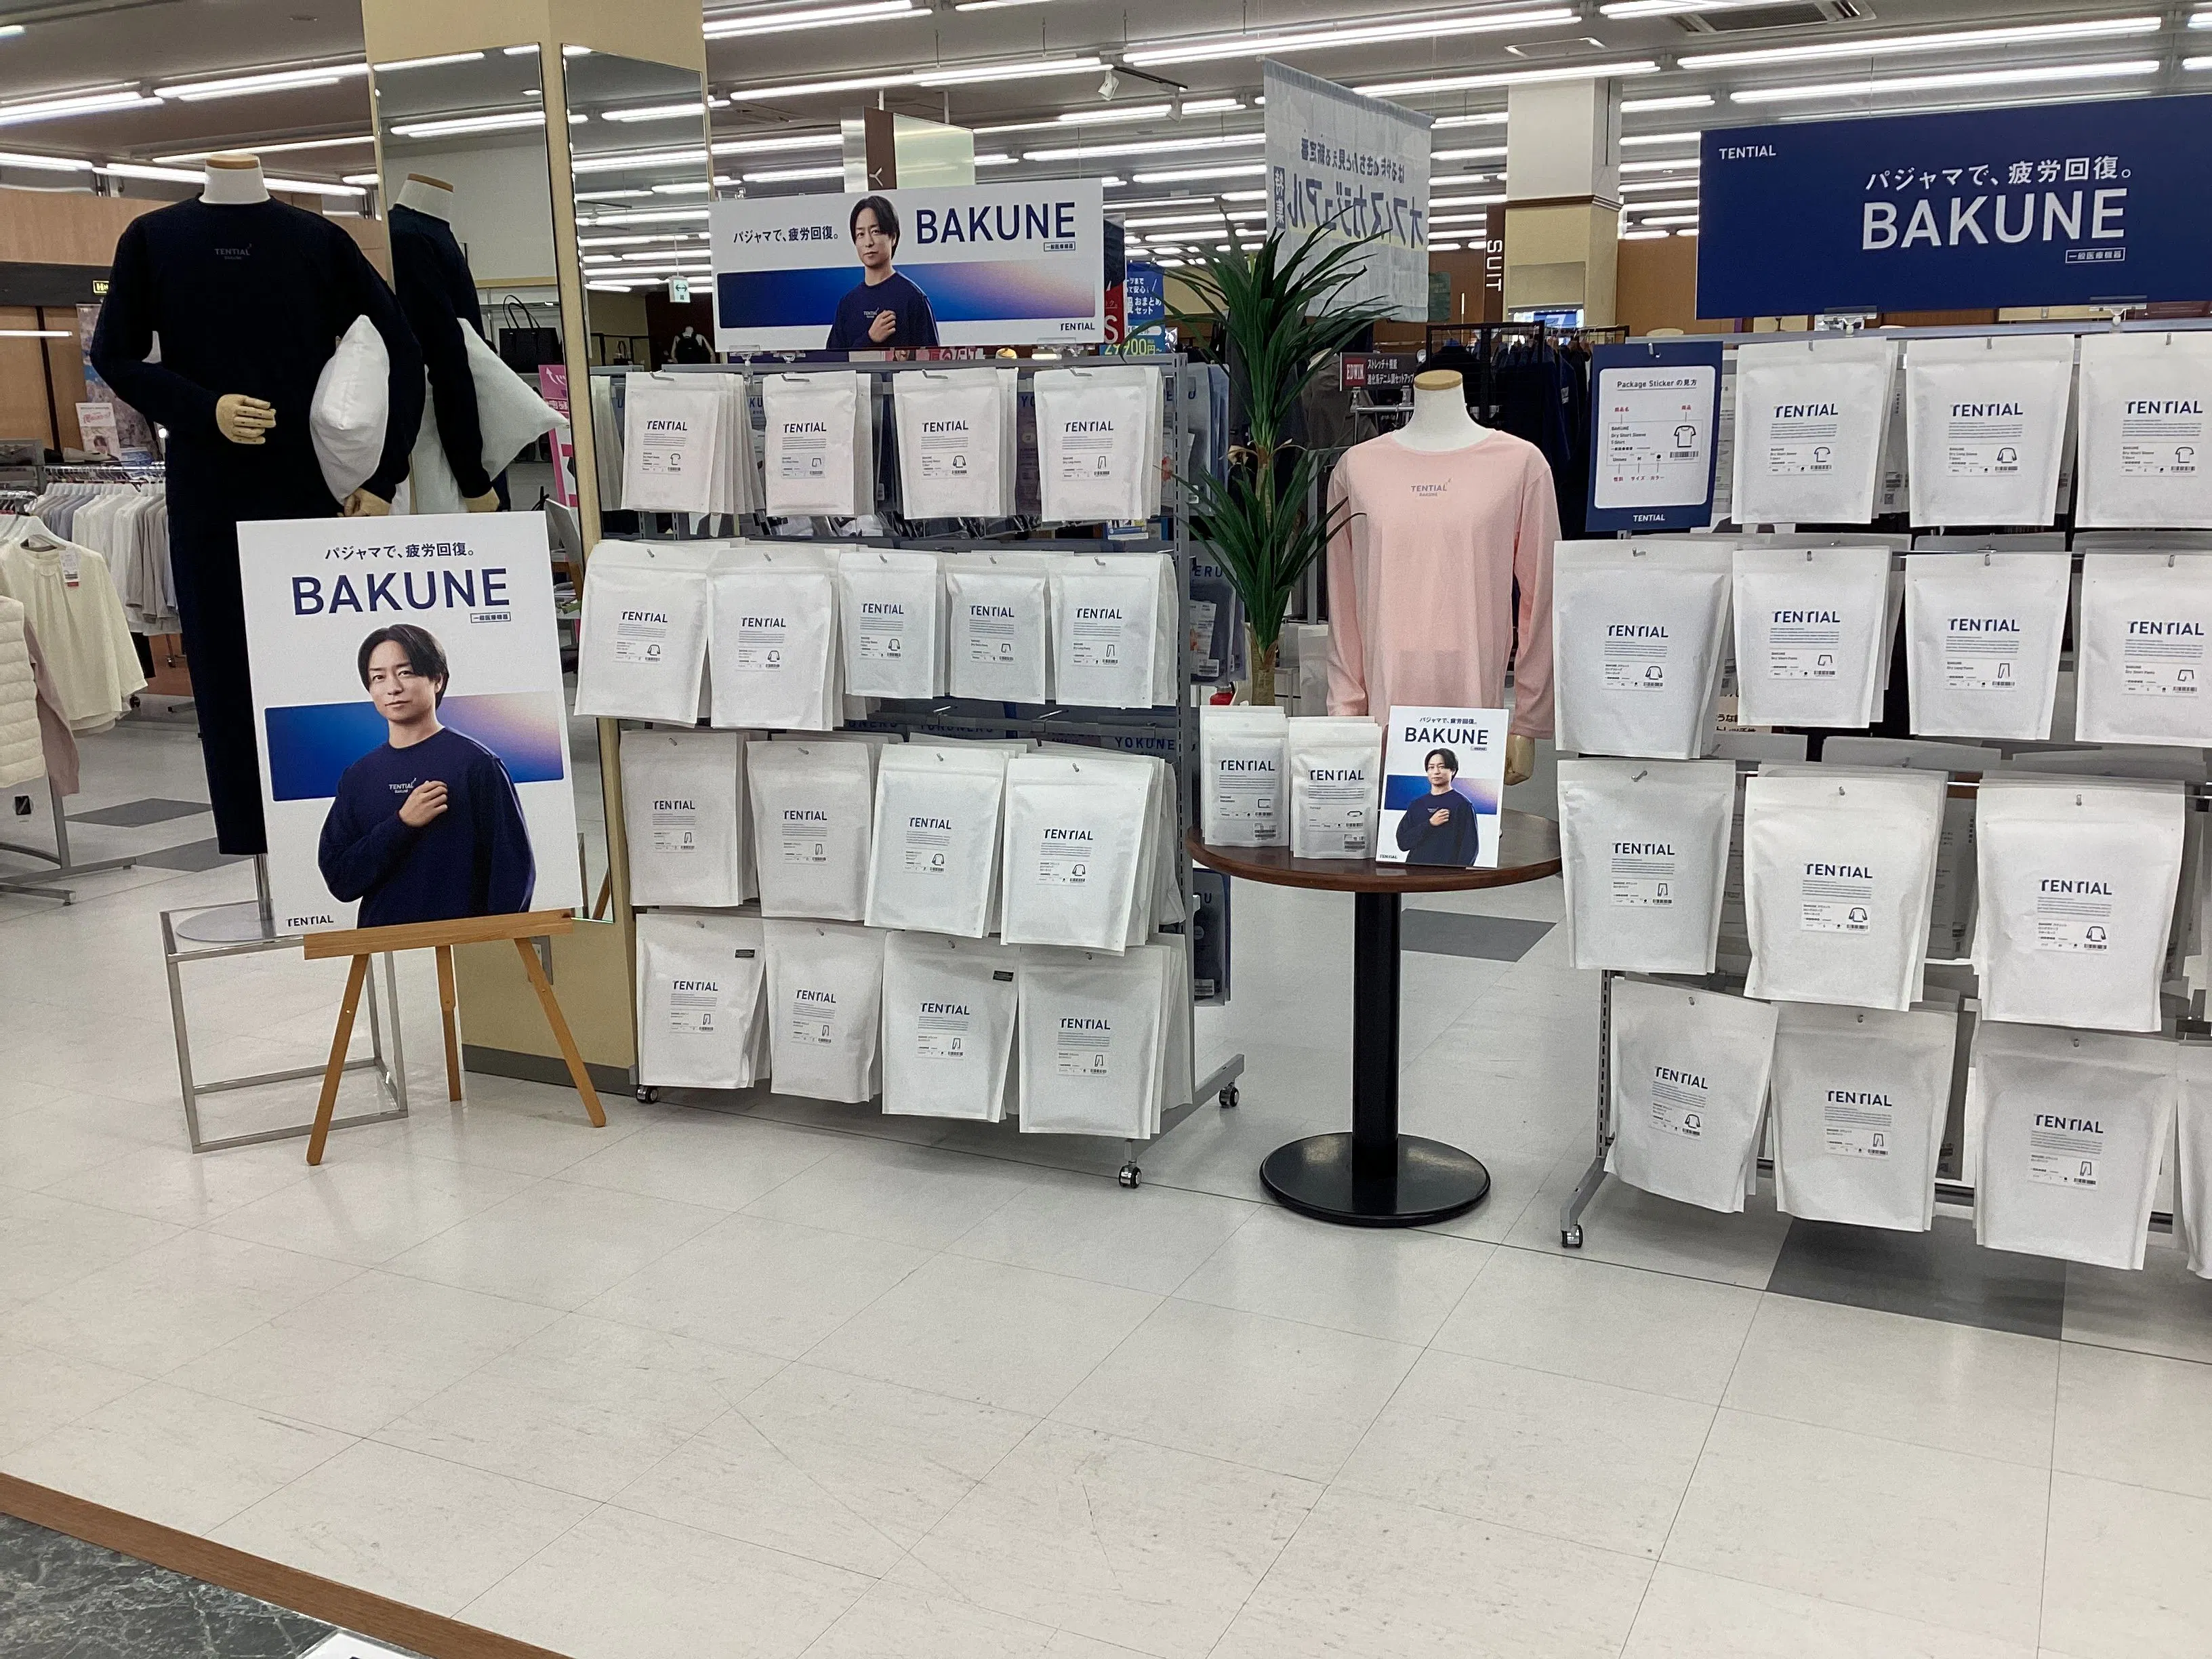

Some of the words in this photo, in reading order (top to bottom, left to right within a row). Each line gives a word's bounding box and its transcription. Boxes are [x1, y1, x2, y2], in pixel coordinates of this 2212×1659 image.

[1719, 144, 1776, 159] TENTIAL
[1866, 155, 2131, 190] パジャマで、疲労回復。
[916, 202, 1076, 244] BAKUNE
[1862, 188, 2128, 250] BAKUNE
[733, 226, 838, 243] パジャマで、疲労回復。
[1486, 240, 1502, 291] SUIT
[1060, 323, 1095, 331] TENTIAL
[1347, 364, 1364, 380] EDWIN
[1617, 380, 1647, 388] Package
[1774, 403, 1839, 418] TENTIAL
[1950, 403, 2024, 417] TENTIAL
[2125, 401, 2203, 414] TENTIAL
[647, 420, 688, 431] TENTIAL
[783, 422, 827, 433] TENTIAL
[922, 420, 969, 432] TENTIAL
[1065, 420, 1113, 432] TENTIAL
[1411, 484, 1448, 492] TENTIAL
[1633, 514, 1666, 522] TENTIAL
[325, 543, 474, 560] パジャマで、疲労回復。
[292, 568, 510, 615] BAKUNE
[861, 603, 904, 615] TENTIAL
[970, 605, 1015, 618] TENTIAL
[1076, 608, 1122, 619] TENTIAL
[621, 611, 668, 623] TENTIAL
[741, 617, 786, 628] TENTIAL
[1771, 611, 1841, 623] TENTIAL
[1606, 625, 1668, 638] TENTIAL
[1948, 618, 2020, 632] TENTIAL
[2127, 621, 2204, 636] TENTIAL
[1404, 726, 1489, 745] BAKUNE
[1219, 760, 1275, 771] TENTIAL
[1308, 770, 1365, 781] TENTIAL
[653, 800, 695, 810] TENTIAL
[783, 810, 827, 821] TENTIAL
[909, 817, 951, 830] TENTIAL
[1043, 829, 1093, 840] TENTIAL
[1612, 842, 1675, 855] TENTIAL
[1804, 863, 1873, 879] TENTIAL
[2039, 879, 2112, 895] TENTIAL
[286, 915, 334, 927] TENTIAL
[672, 981, 718, 991] TENTIAL
[796, 989, 836, 1003] TENTIAL
[920, 1003, 970, 1015] TENTIAL
[1060, 1018, 1111, 1030] TENTIAL
[1654, 1065, 1708, 1090] TENTIAL
[1825, 1090, 1892, 1107] TENTIAL
[2034, 1113, 2104, 1134] TENTIAL
